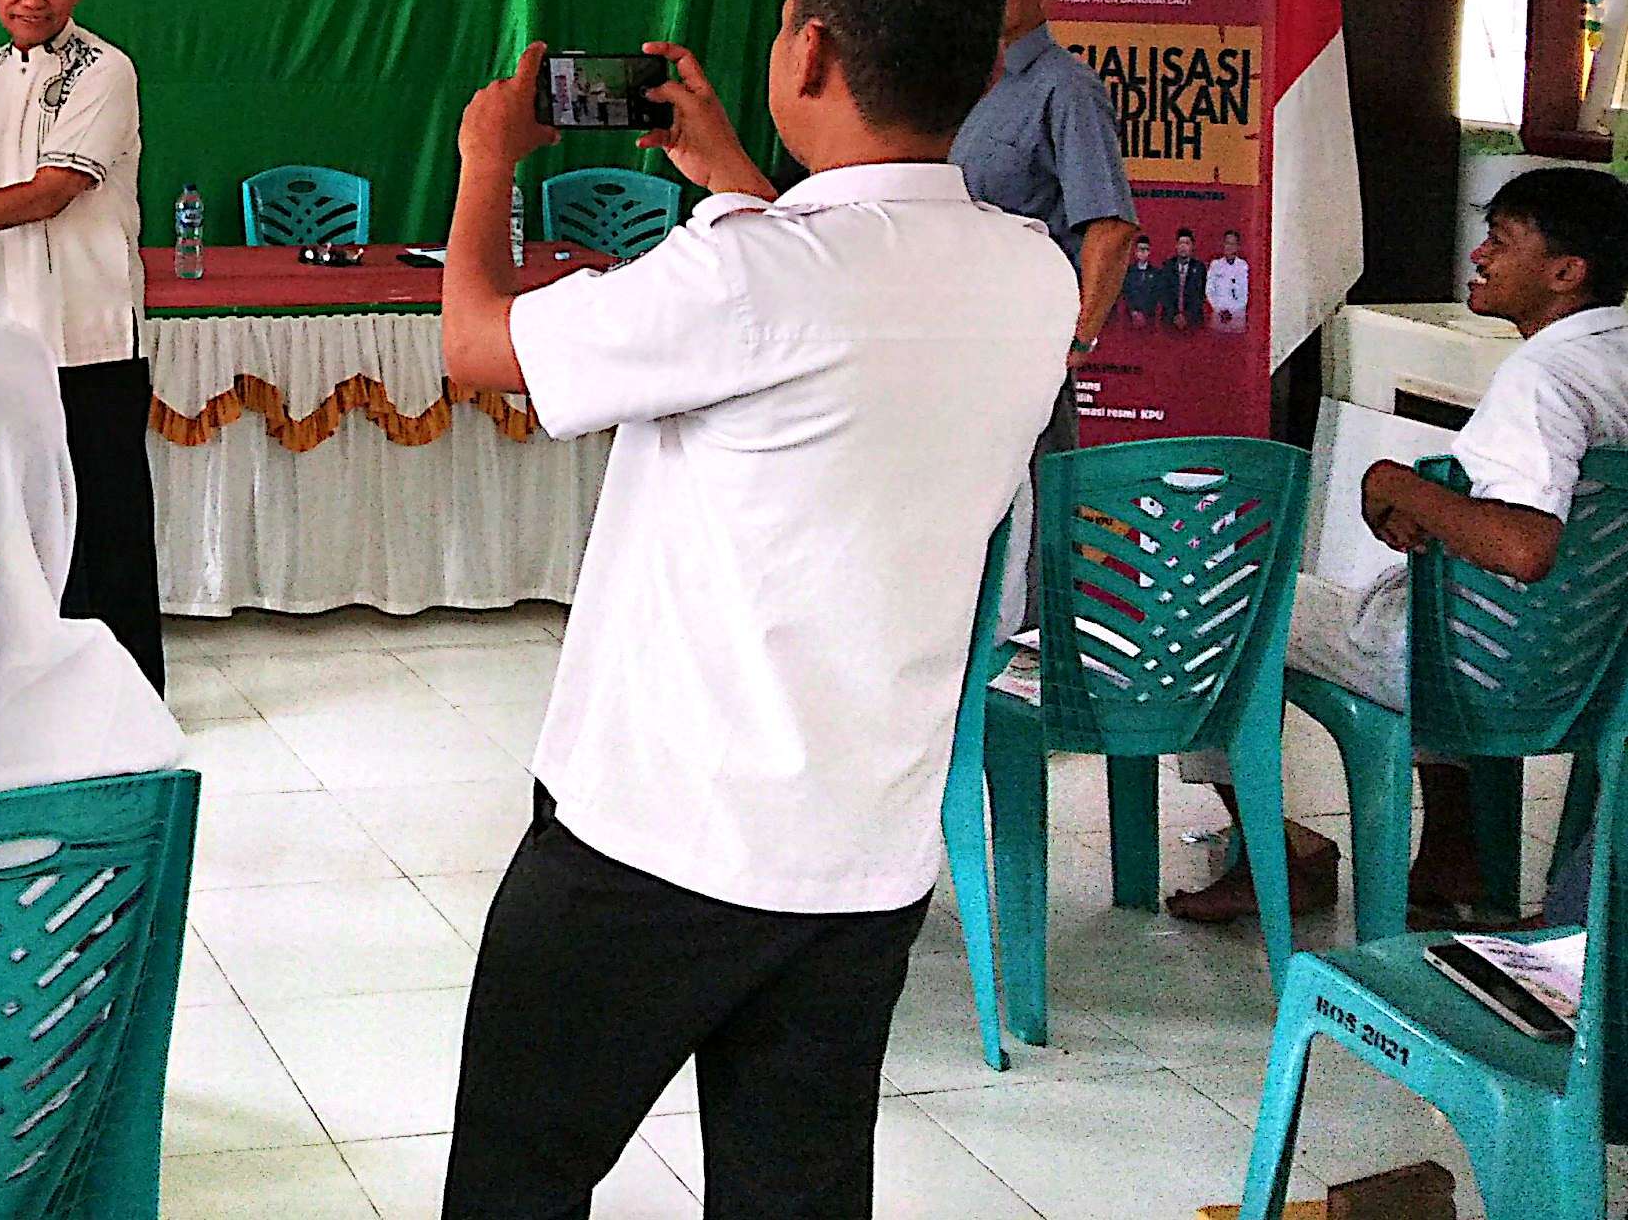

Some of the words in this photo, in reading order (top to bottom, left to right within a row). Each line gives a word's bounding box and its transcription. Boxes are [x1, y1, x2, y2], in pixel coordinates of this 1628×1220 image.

[1067, 44, 1251, 87] IALISASI
[1110, 82, 1249, 125] IDIKAN
[1107, 408, 1137, 419] resmi
[1140, 409, 1164, 420] KPU
[1361, 1024, 1410, 1067] 2021
